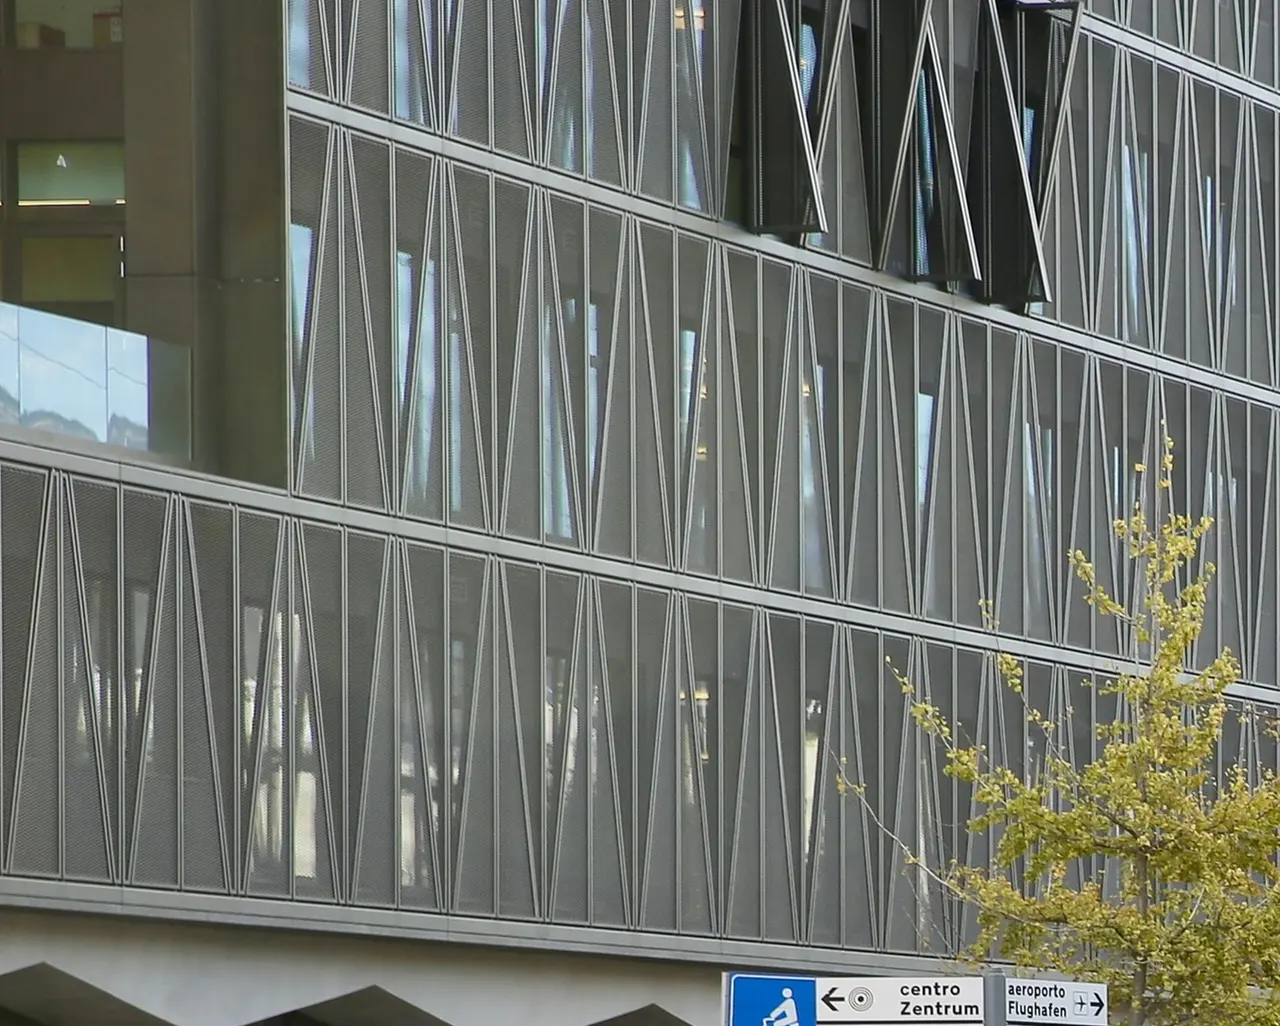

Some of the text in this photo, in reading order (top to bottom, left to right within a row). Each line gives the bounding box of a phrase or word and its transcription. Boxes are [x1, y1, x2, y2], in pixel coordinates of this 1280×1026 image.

[900, 982, 960, 996] centro
[1008, 984, 1066, 999] aeroporto
[900, 1001, 979, 1016] Zentrum
[1008, 1001, 1067, 1018] Flughafen
